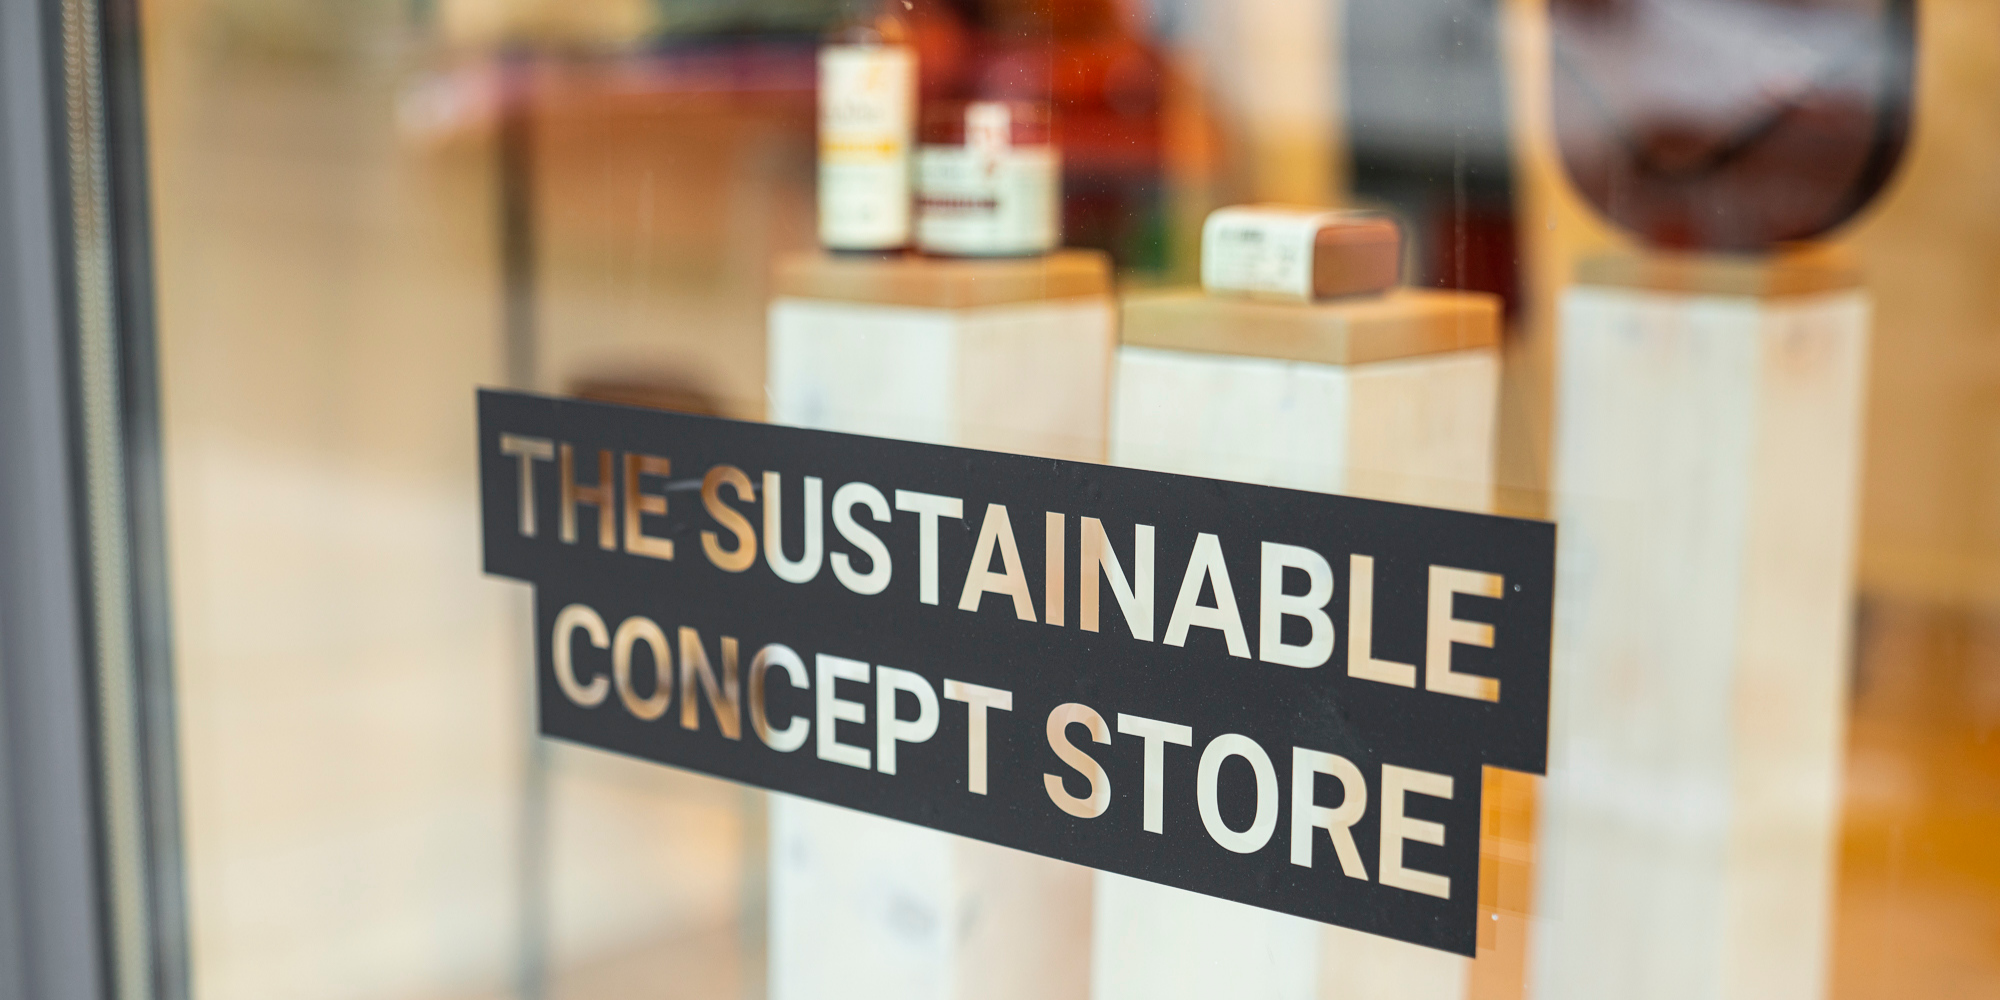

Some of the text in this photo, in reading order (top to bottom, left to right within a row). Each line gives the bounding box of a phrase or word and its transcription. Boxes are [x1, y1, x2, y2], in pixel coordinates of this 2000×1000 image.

[500, 433, 1505, 703] THE SUSTAINABLE
[551, 603, 1454, 900] CONCEPT STORE
